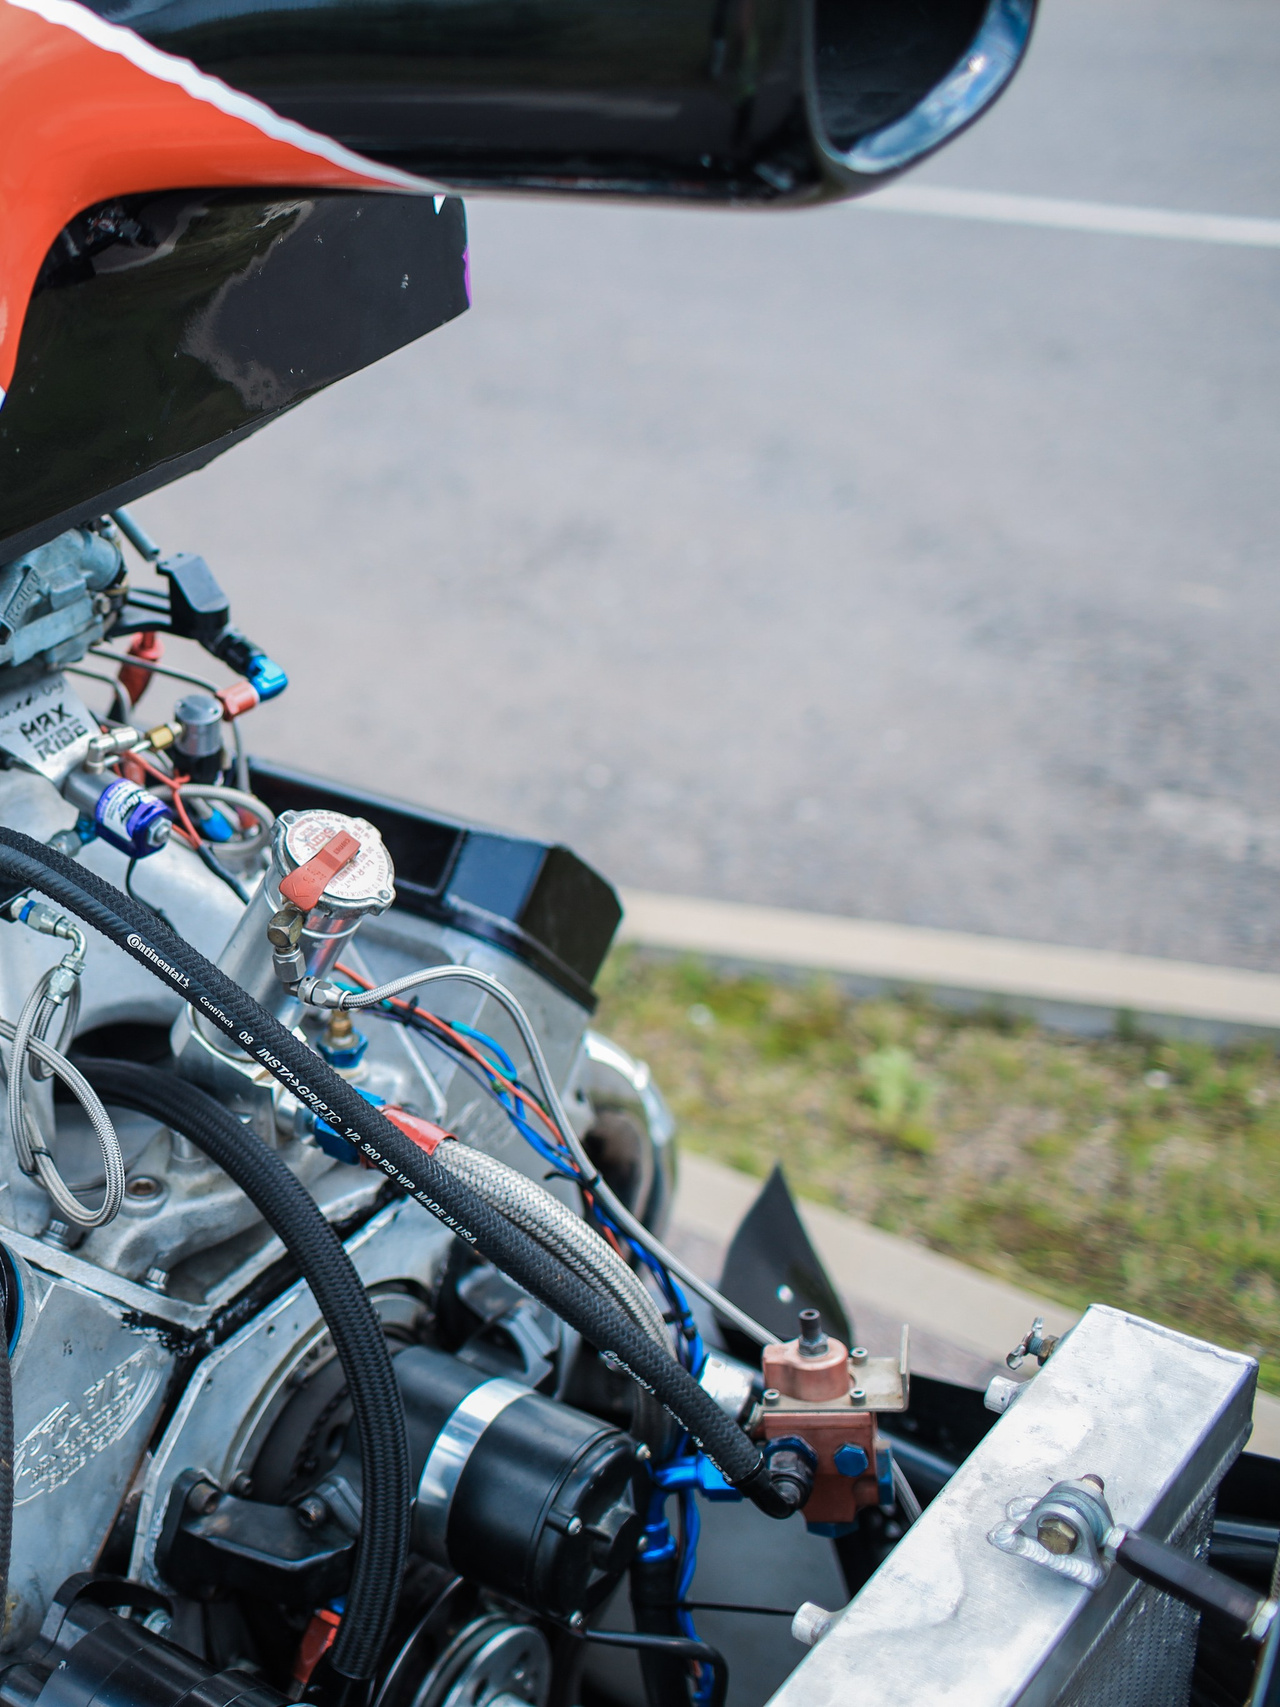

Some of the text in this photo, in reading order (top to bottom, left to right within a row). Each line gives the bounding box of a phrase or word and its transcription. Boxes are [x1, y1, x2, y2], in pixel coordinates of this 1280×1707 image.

[126, 933, 185, 985] Continental
[199, 996, 234, 1029] ContiTech
[238, 1031, 254, 1045] 08
[344, 1127, 361, 1143] 1/2
[361, 1143, 381, 1160] 300
[380, 1159, 399, 1176] PSI
[396, 1173, 416, 1190] WP
[414, 1190, 447, 1218] MADE
[443, 1215, 458, 1227] IN
[455, 1225, 478, 1245] USA
